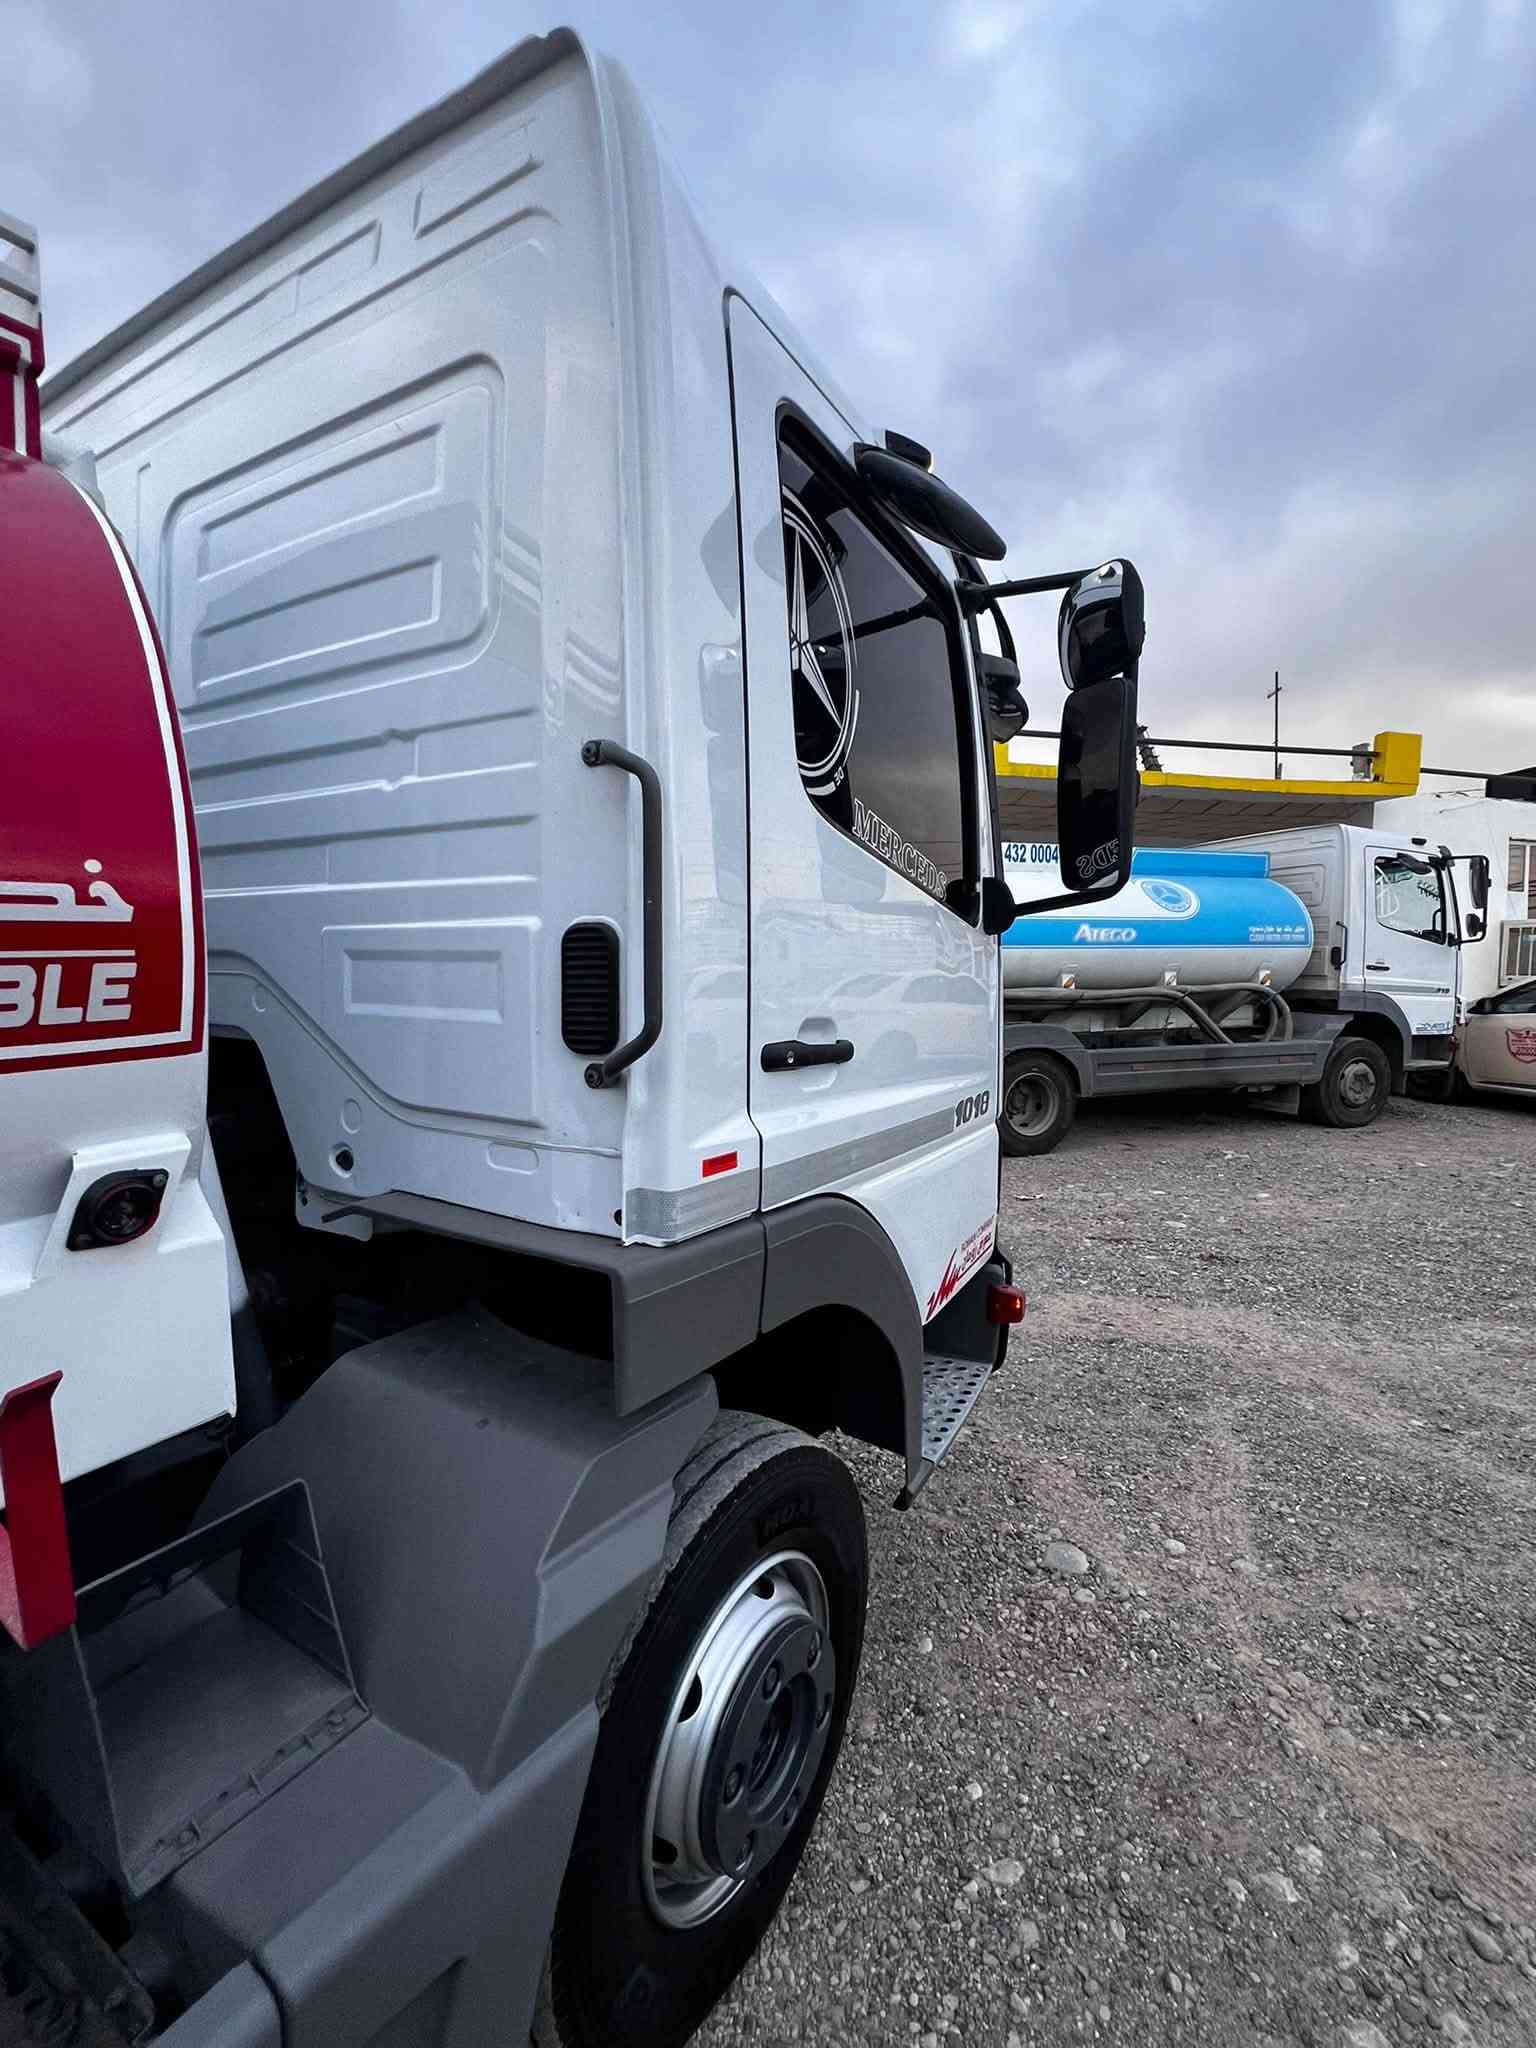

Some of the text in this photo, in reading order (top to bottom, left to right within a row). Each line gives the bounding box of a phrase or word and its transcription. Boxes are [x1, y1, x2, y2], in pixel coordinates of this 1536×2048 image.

[1004, 843, 1059, 864] 432 0004
[0, 962, 138, 1028] BLE
[955, 1089, 990, 1128] 1018
